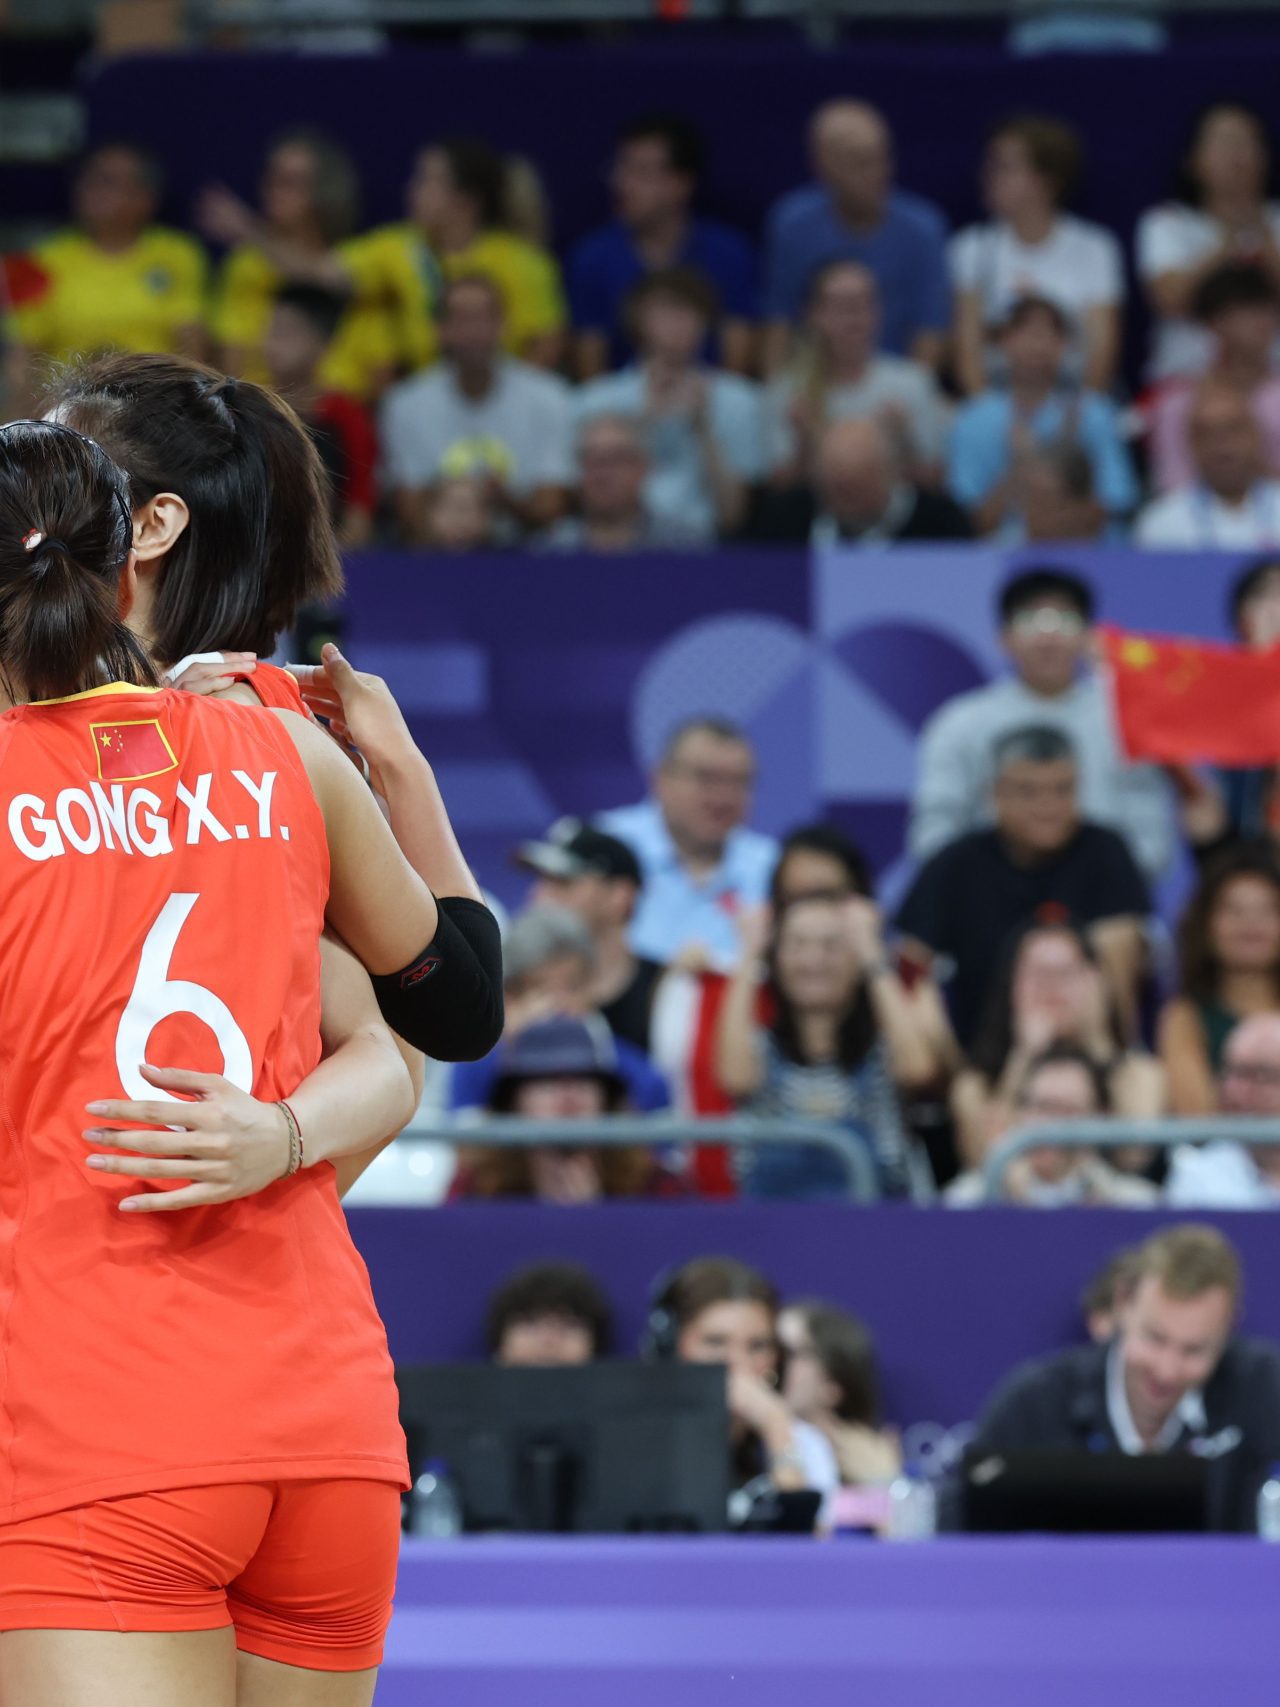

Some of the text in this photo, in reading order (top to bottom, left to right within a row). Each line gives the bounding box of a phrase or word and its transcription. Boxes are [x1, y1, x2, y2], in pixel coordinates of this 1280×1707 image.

[7, 769, 290, 861] GONG X.Y.
[115, 892, 253, 1133] 6
